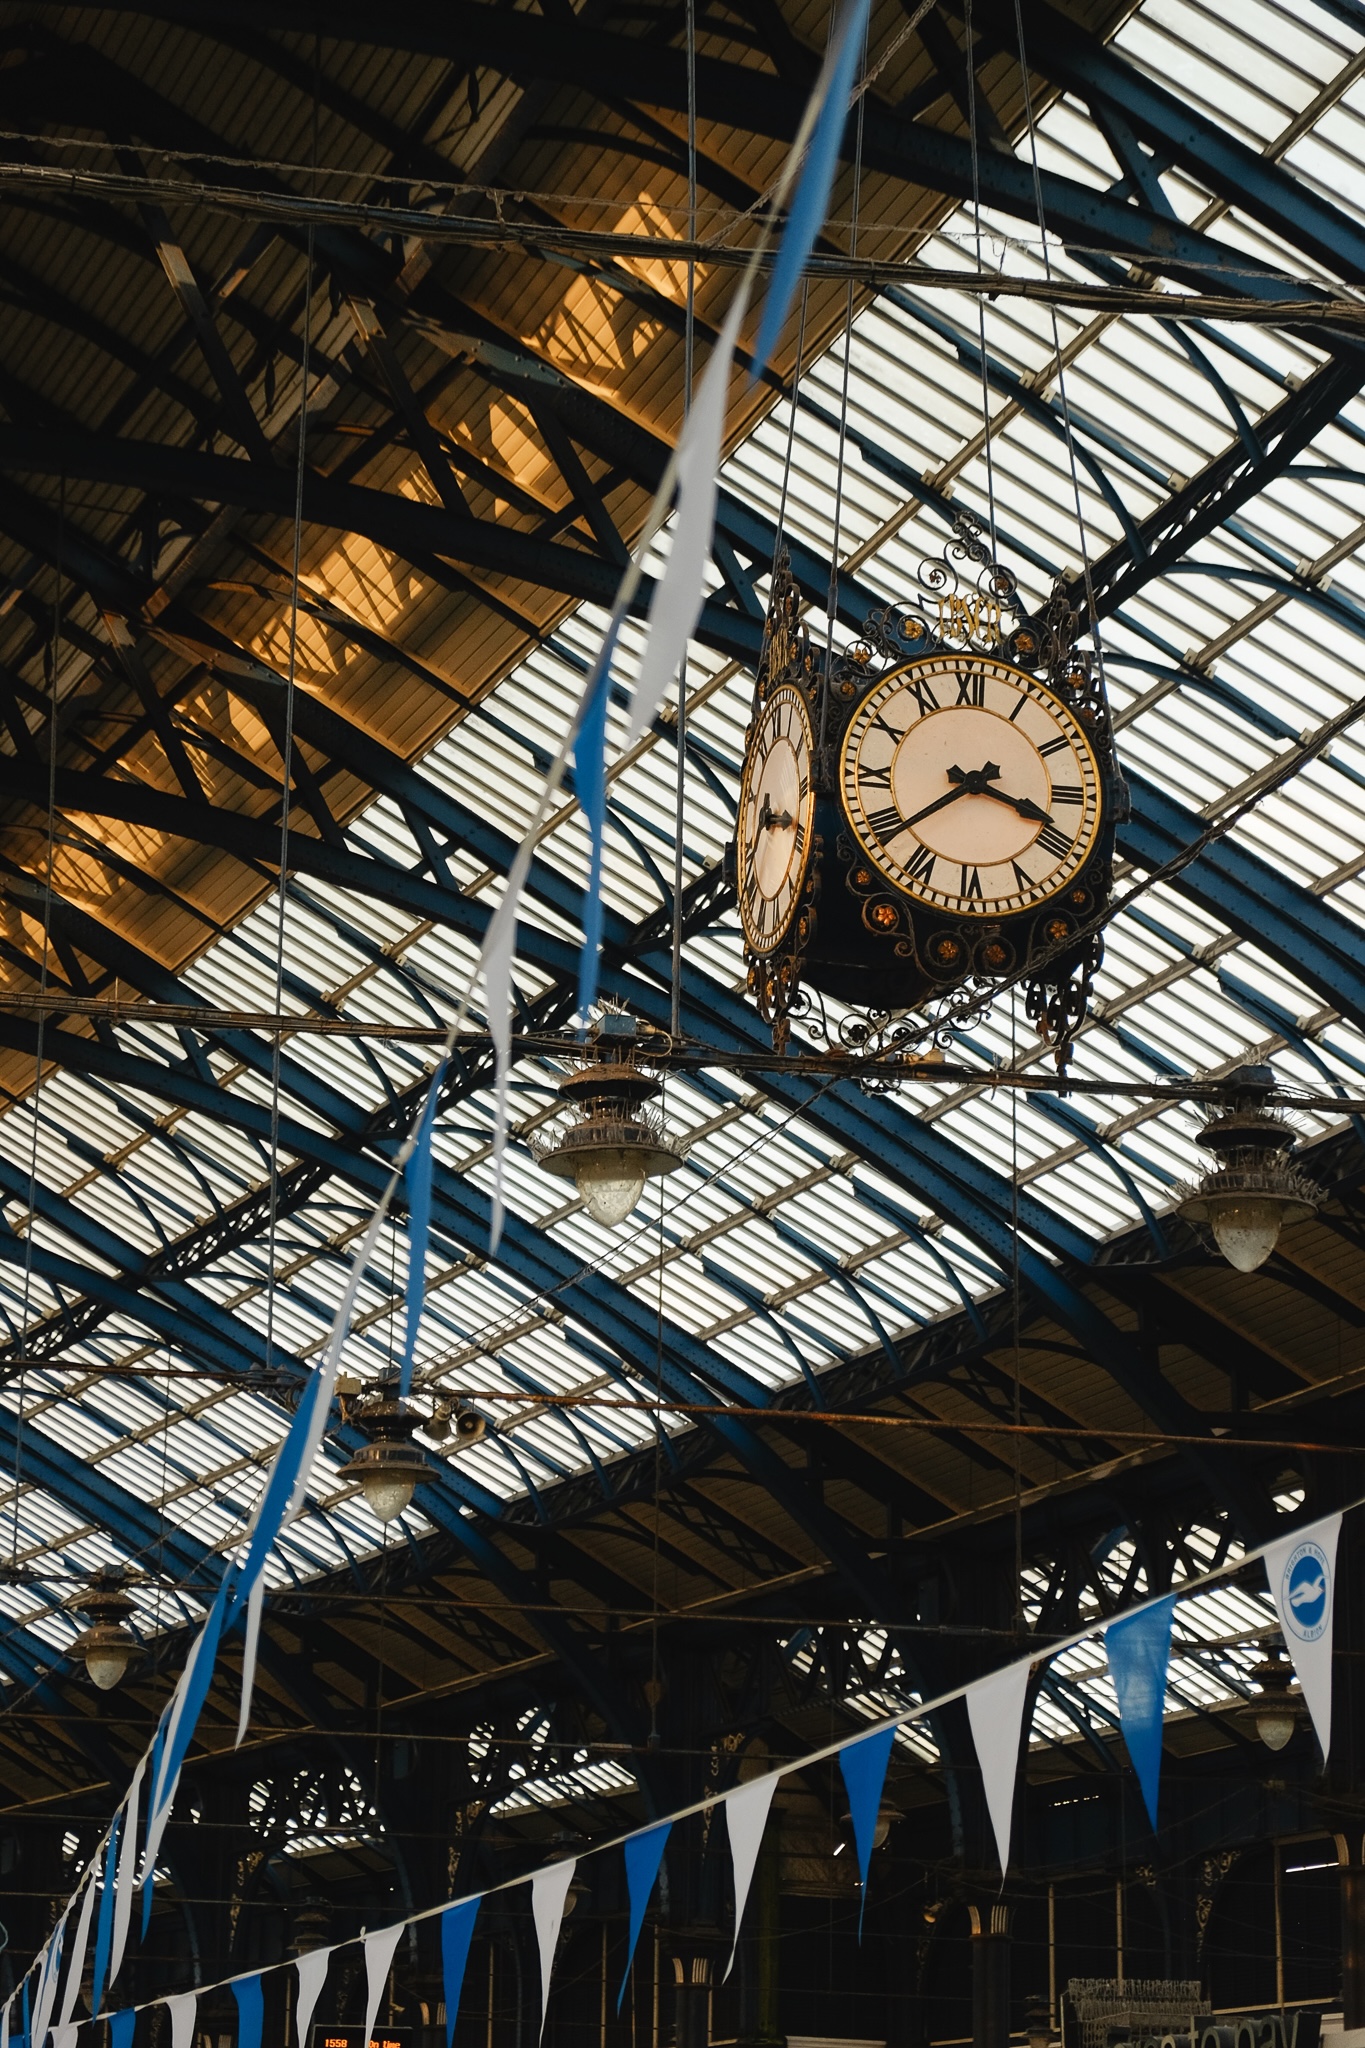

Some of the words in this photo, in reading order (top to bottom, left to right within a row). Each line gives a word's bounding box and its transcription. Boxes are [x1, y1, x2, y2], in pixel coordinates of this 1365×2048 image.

[904, 680, 941, 717] XI
[955, 672, 985, 706] XII
[1008, 693, 1029, 722] I
[870, 713, 906, 745] X
[1037, 734, 1070, 758] II
[858, 763, 892, 789] IX
[1051, 785, 1083, 805] III
[903, 845, 936, 886] VII
[1012, 860, 1037, 891] V
[961, 865, 983, 899] VI
[1303, 1624, 1322, 1638] ALBION
[325, 2039, 348, 2048] 1558
